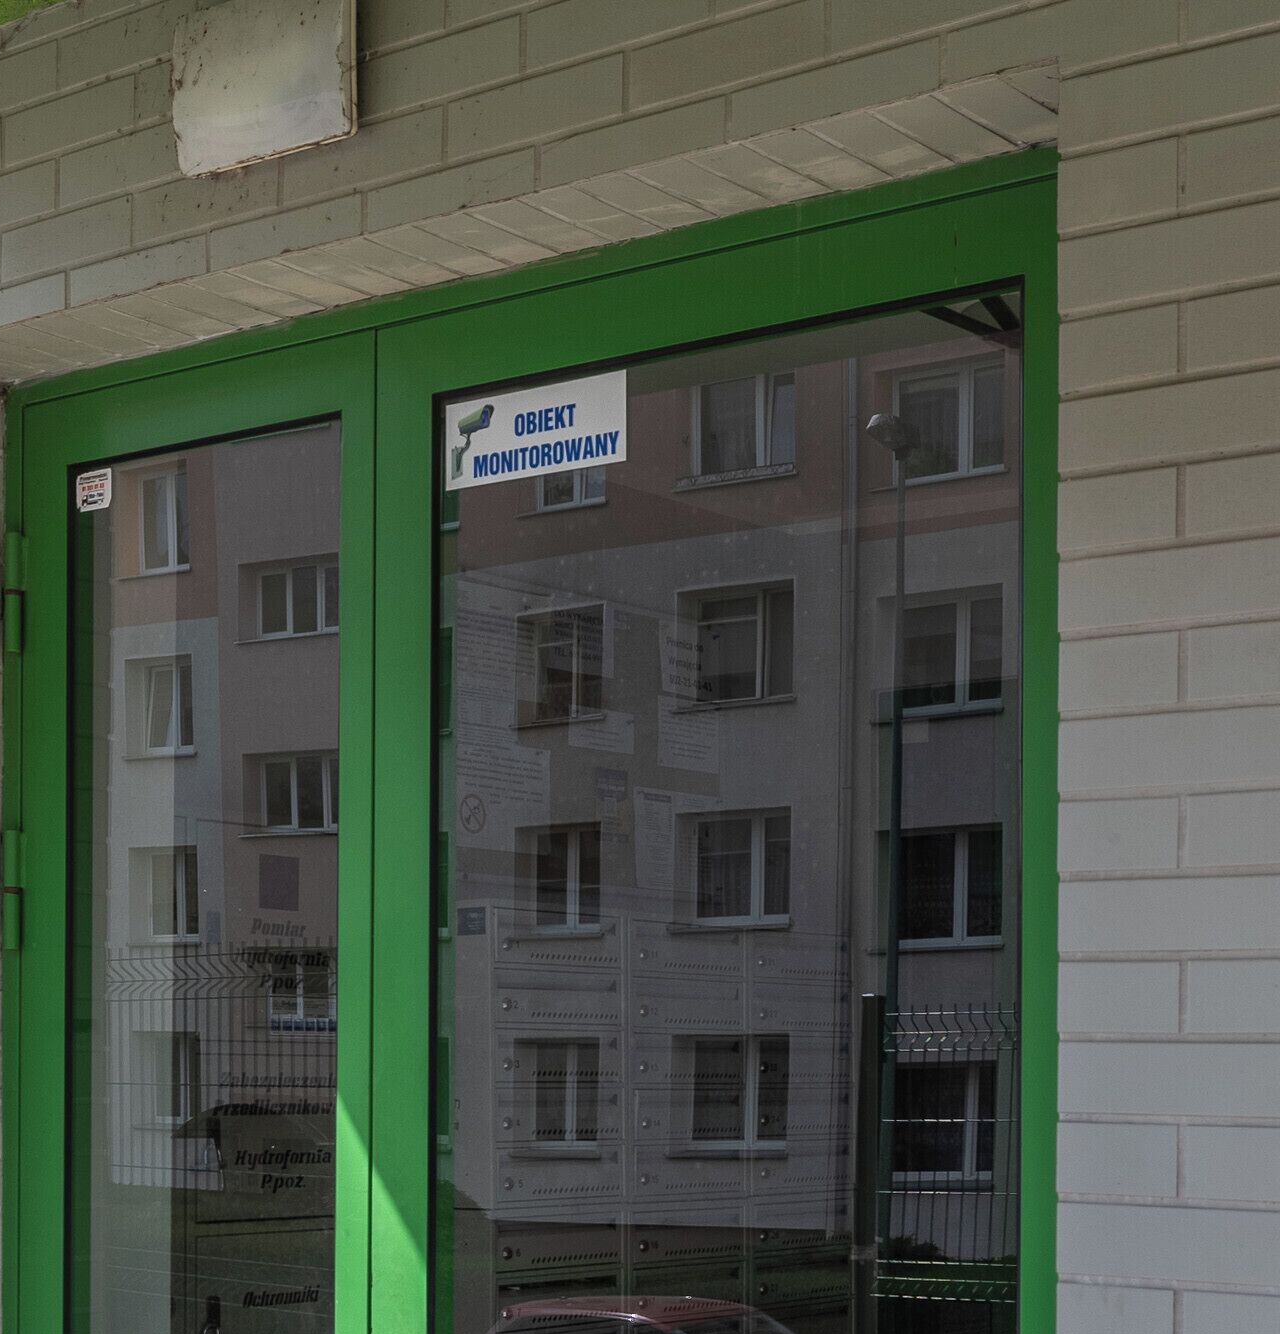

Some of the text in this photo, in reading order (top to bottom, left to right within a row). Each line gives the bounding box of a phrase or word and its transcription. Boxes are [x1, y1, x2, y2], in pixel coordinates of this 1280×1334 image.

[514, 403, 576, 437] OBIEKT
[473, 431, 620, 479] MONITOROWANY
[234, 1149, 332, 1170] Hydrofornia
